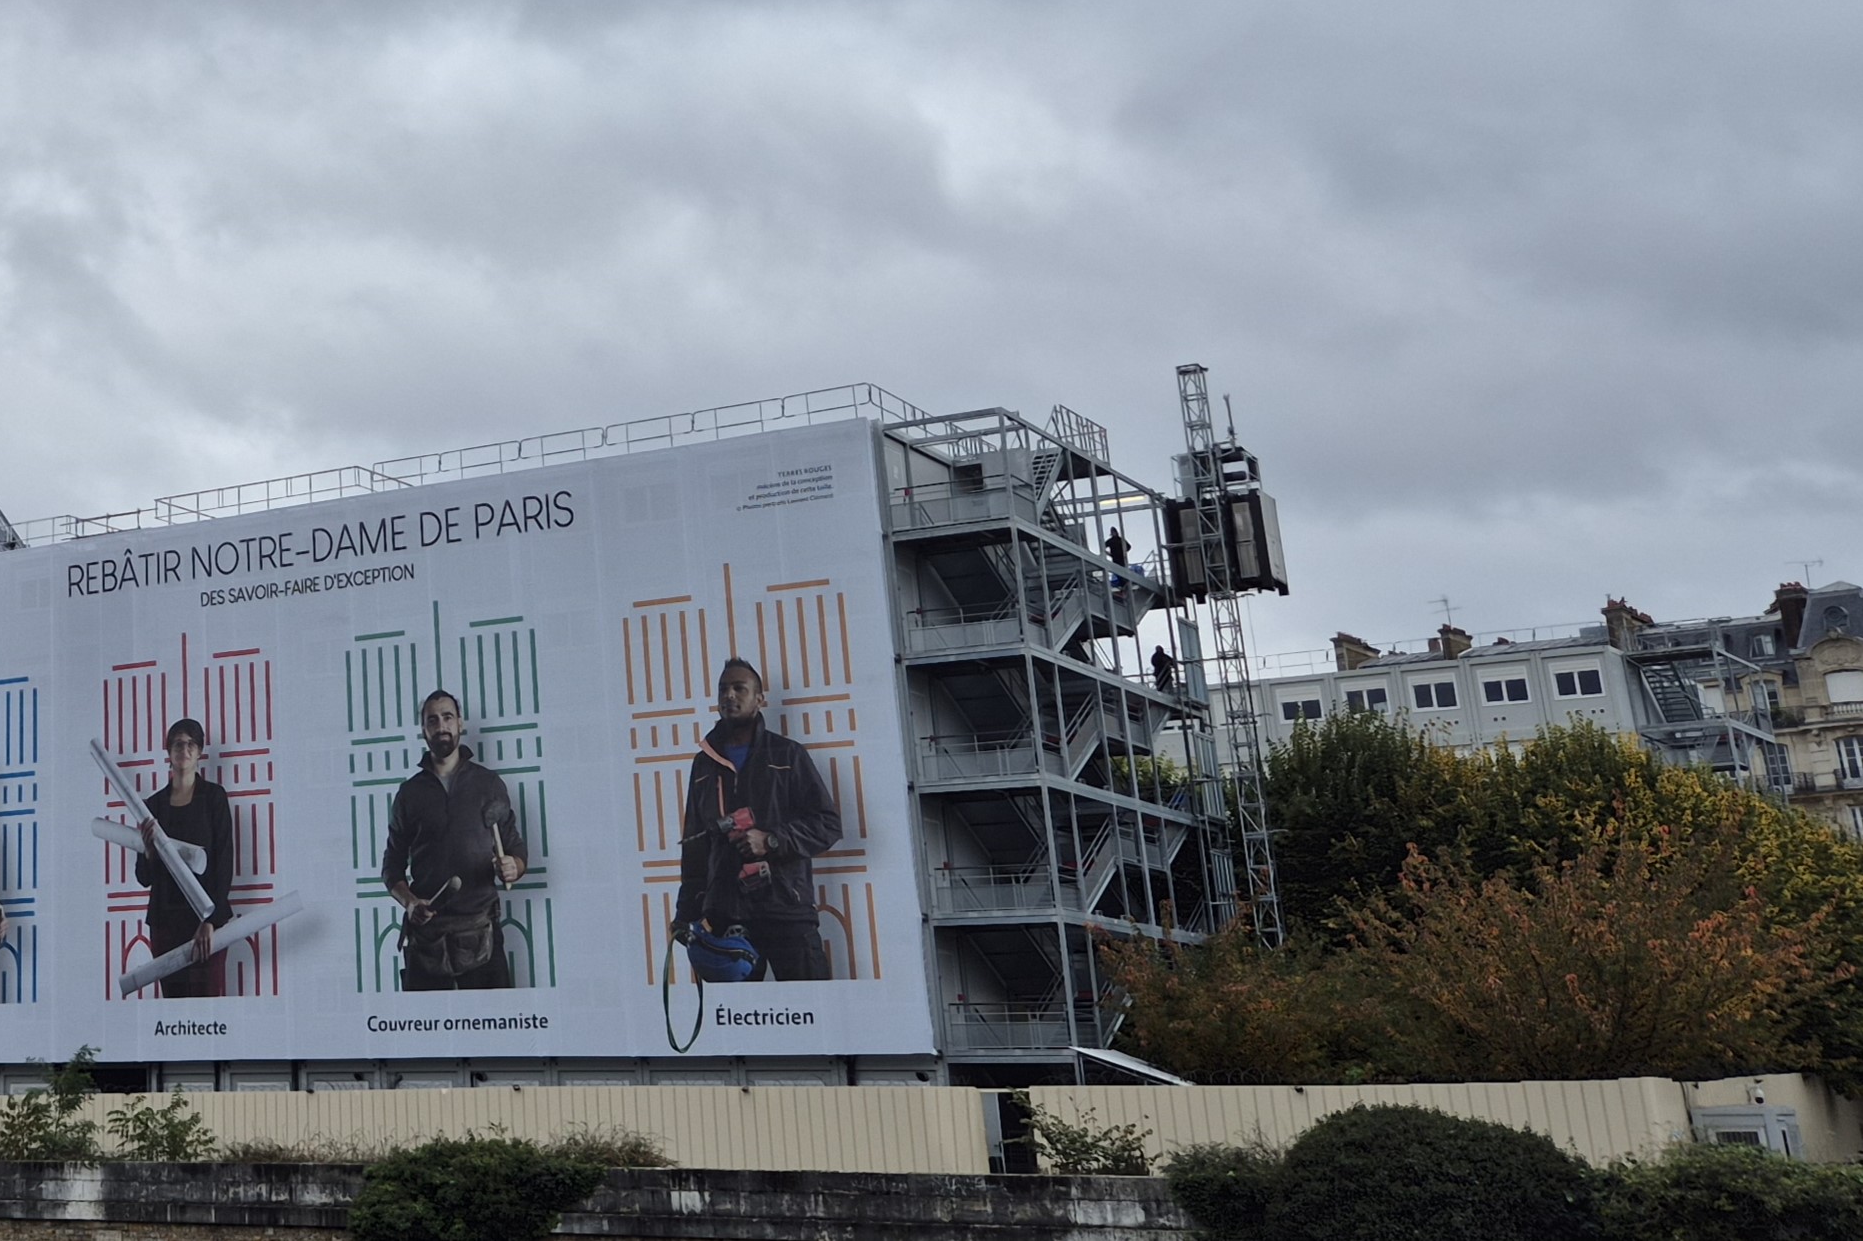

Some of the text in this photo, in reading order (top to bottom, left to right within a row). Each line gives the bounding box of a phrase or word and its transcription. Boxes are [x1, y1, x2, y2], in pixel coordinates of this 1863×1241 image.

[67, 490, 575, 597] REBÂTIR NOTRE-DAME DE PARIS
[200, 563, 415, 607] DES SAVOIR-FAIRE D'EXCEPTION
[367, 1012, 549, 1032] Couvreur ornemaniste
[715, 1003, 815, 1026] Électricien
[154, 1020, 227, 1036] Architecte
